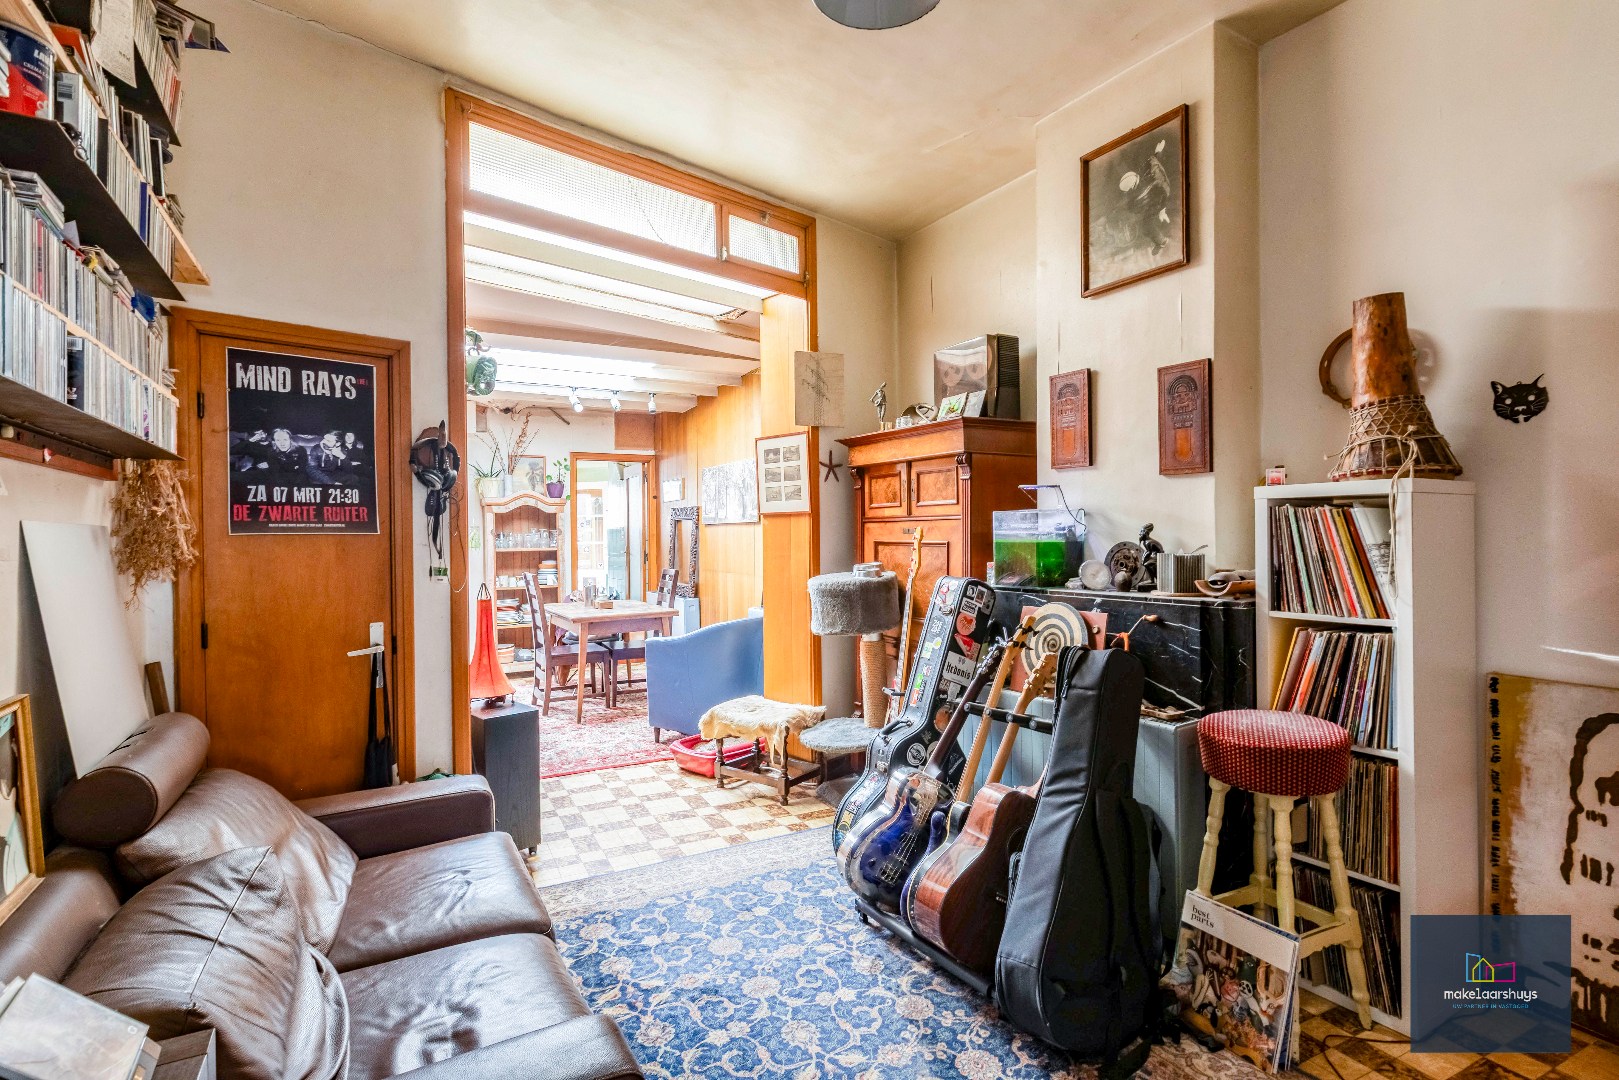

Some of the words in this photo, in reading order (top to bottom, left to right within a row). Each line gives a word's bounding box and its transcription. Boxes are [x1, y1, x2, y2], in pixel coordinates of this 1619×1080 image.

[235, 362, 292, 393] MIND
[302, 370, 357, 400] RAYS
[247, 484, 267, 502] ZA
[273, 487, 288, 503] 07
[293, 486, 323, 503] MRT
[328, 488, 360, 504] 21:30
[233, 504, 252, 522] DE
[258, 505, 318, 522] ZWARTE
[323, 506, 369, 522] RUITER
[1190, 913, 1215, 928] parts
[1192, 904, 1210, 919] best
